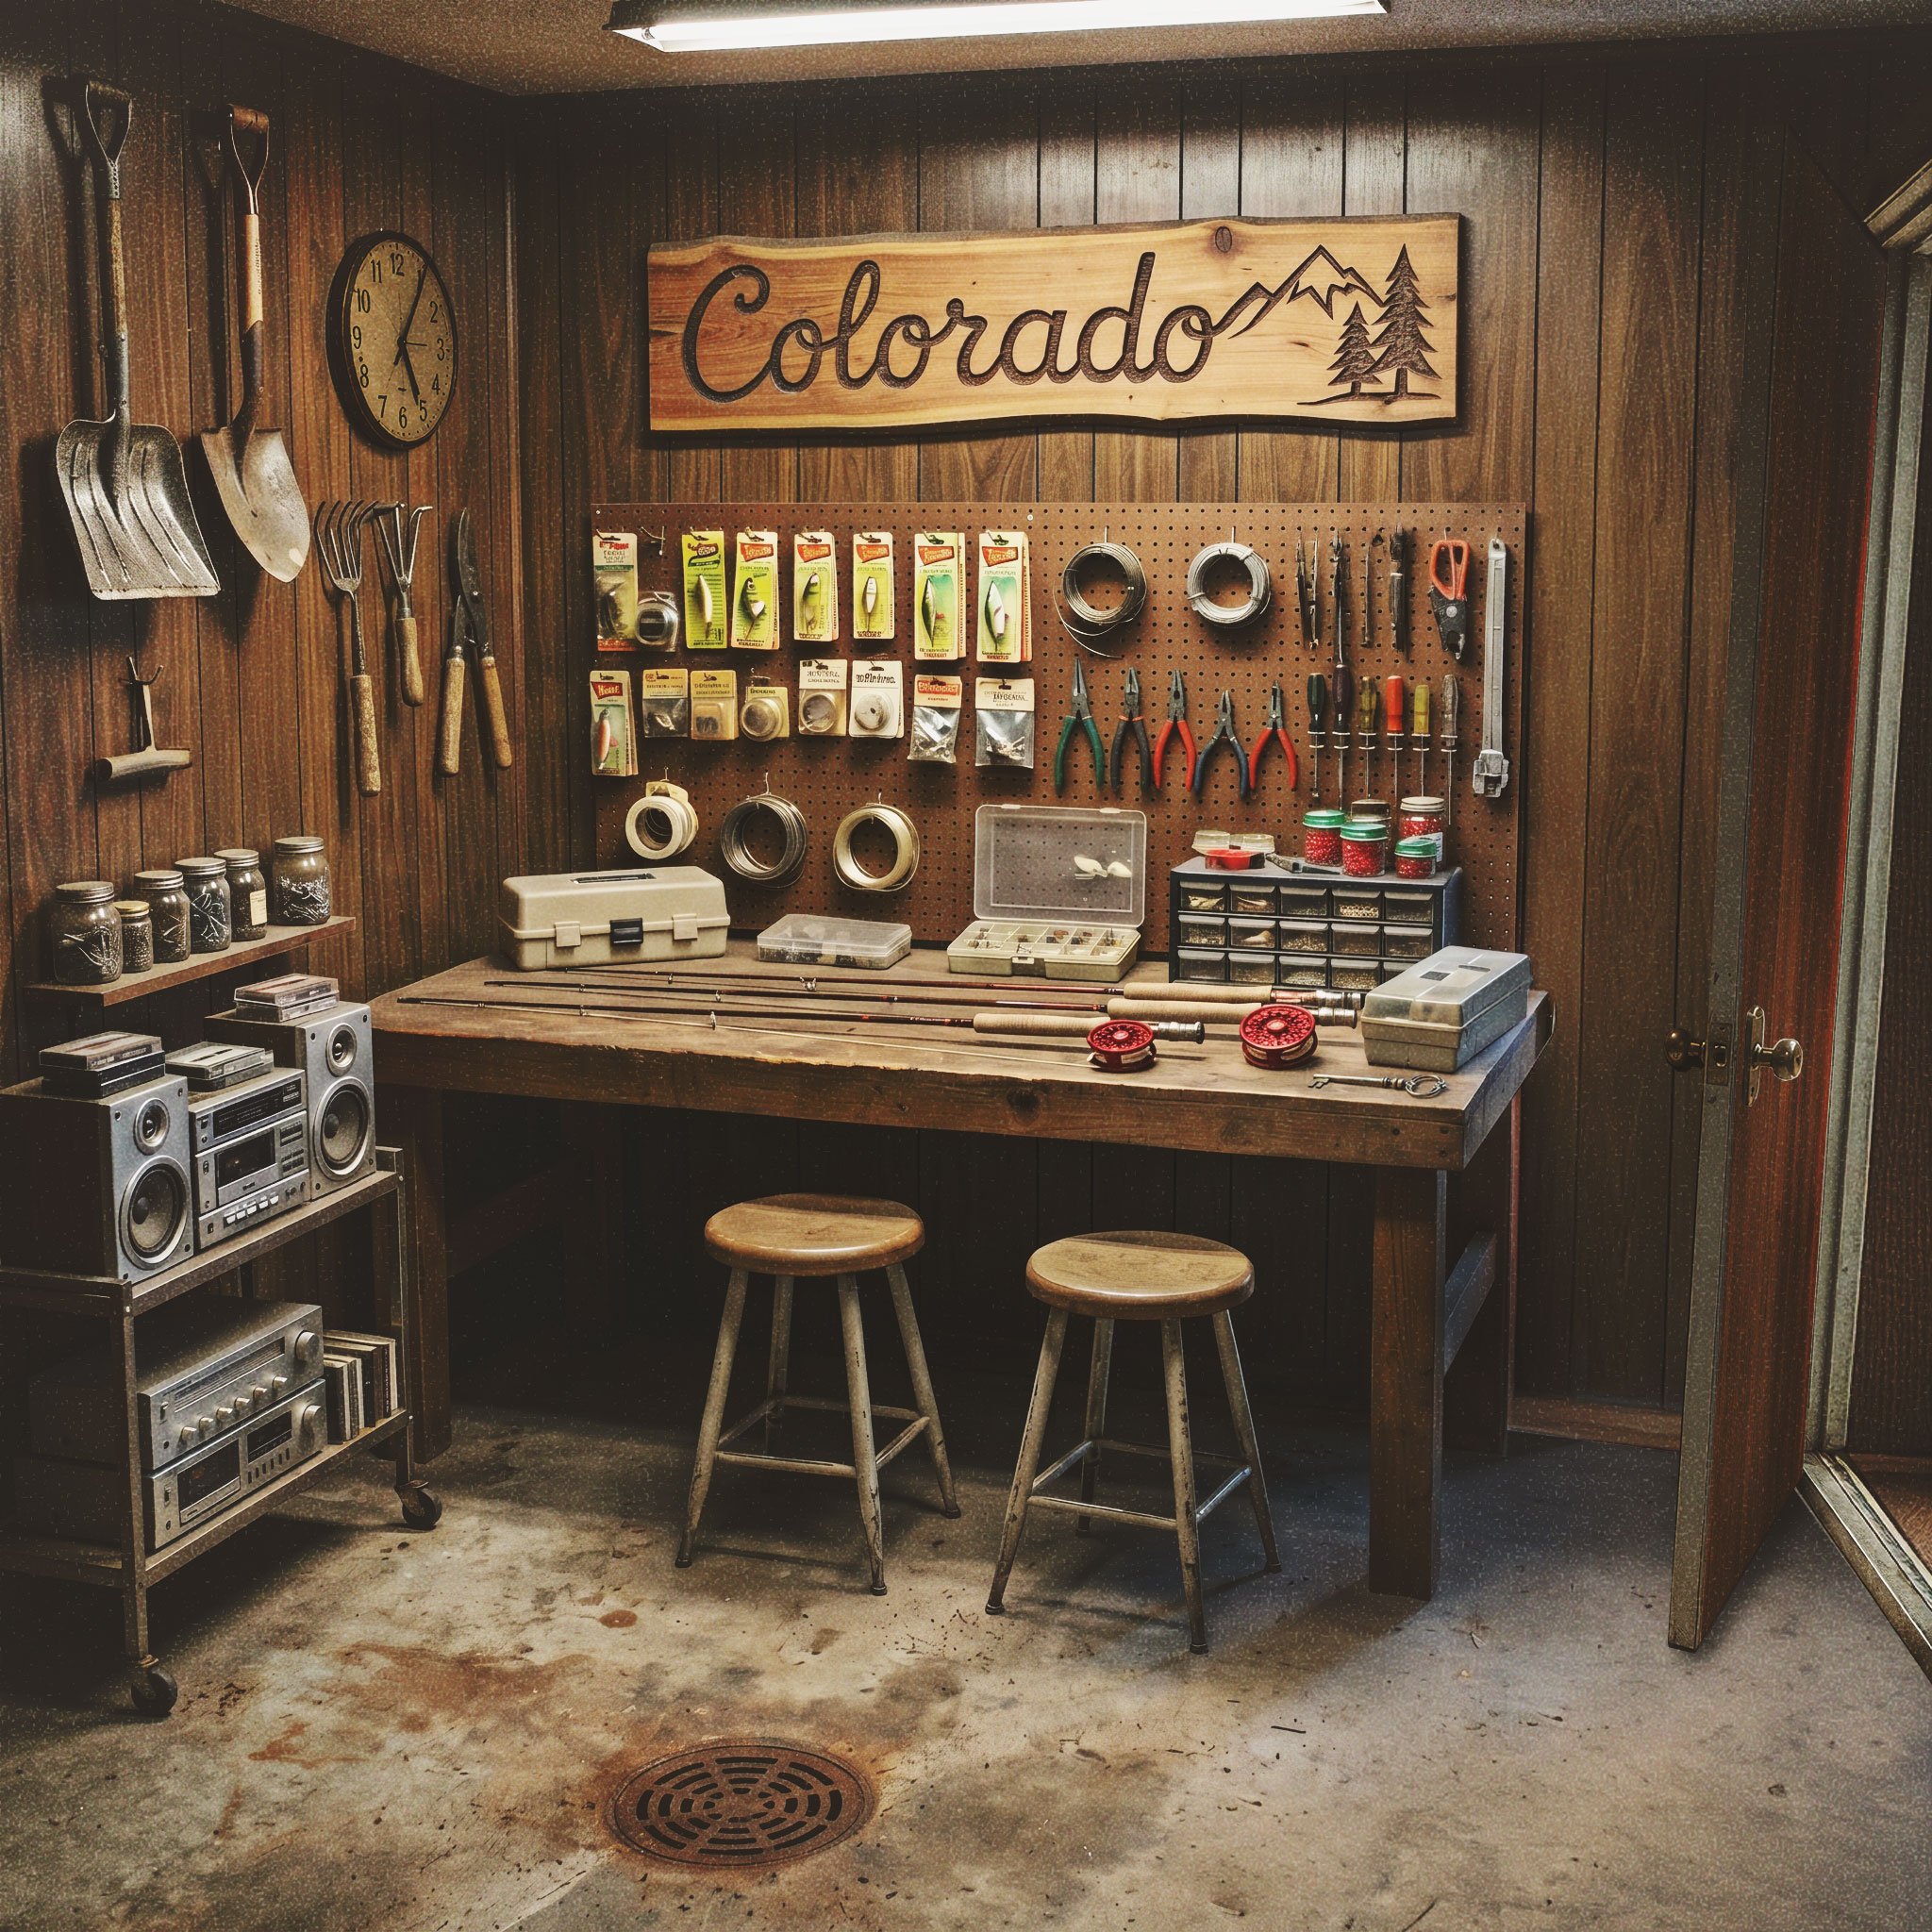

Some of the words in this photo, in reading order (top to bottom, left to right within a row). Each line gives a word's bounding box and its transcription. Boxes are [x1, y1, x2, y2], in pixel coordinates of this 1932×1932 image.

[370, 259, 382, 283] 11
[390, 253, 405, 276] 12
[354, 288, 371, 313] 10
[429, 301, 438, 324] 2
[352, 325, 362, 349] 9
[682, 252, 1219, 403] Colorado
[437, 338, 445, 361] 3
[359, 364, 369, 388] 8
[431, 374, 441, 395] 4
[377, 395, 388, 418] 7
[398, 407, 408, 428] 6
[419, 400, 428, 422] 5
